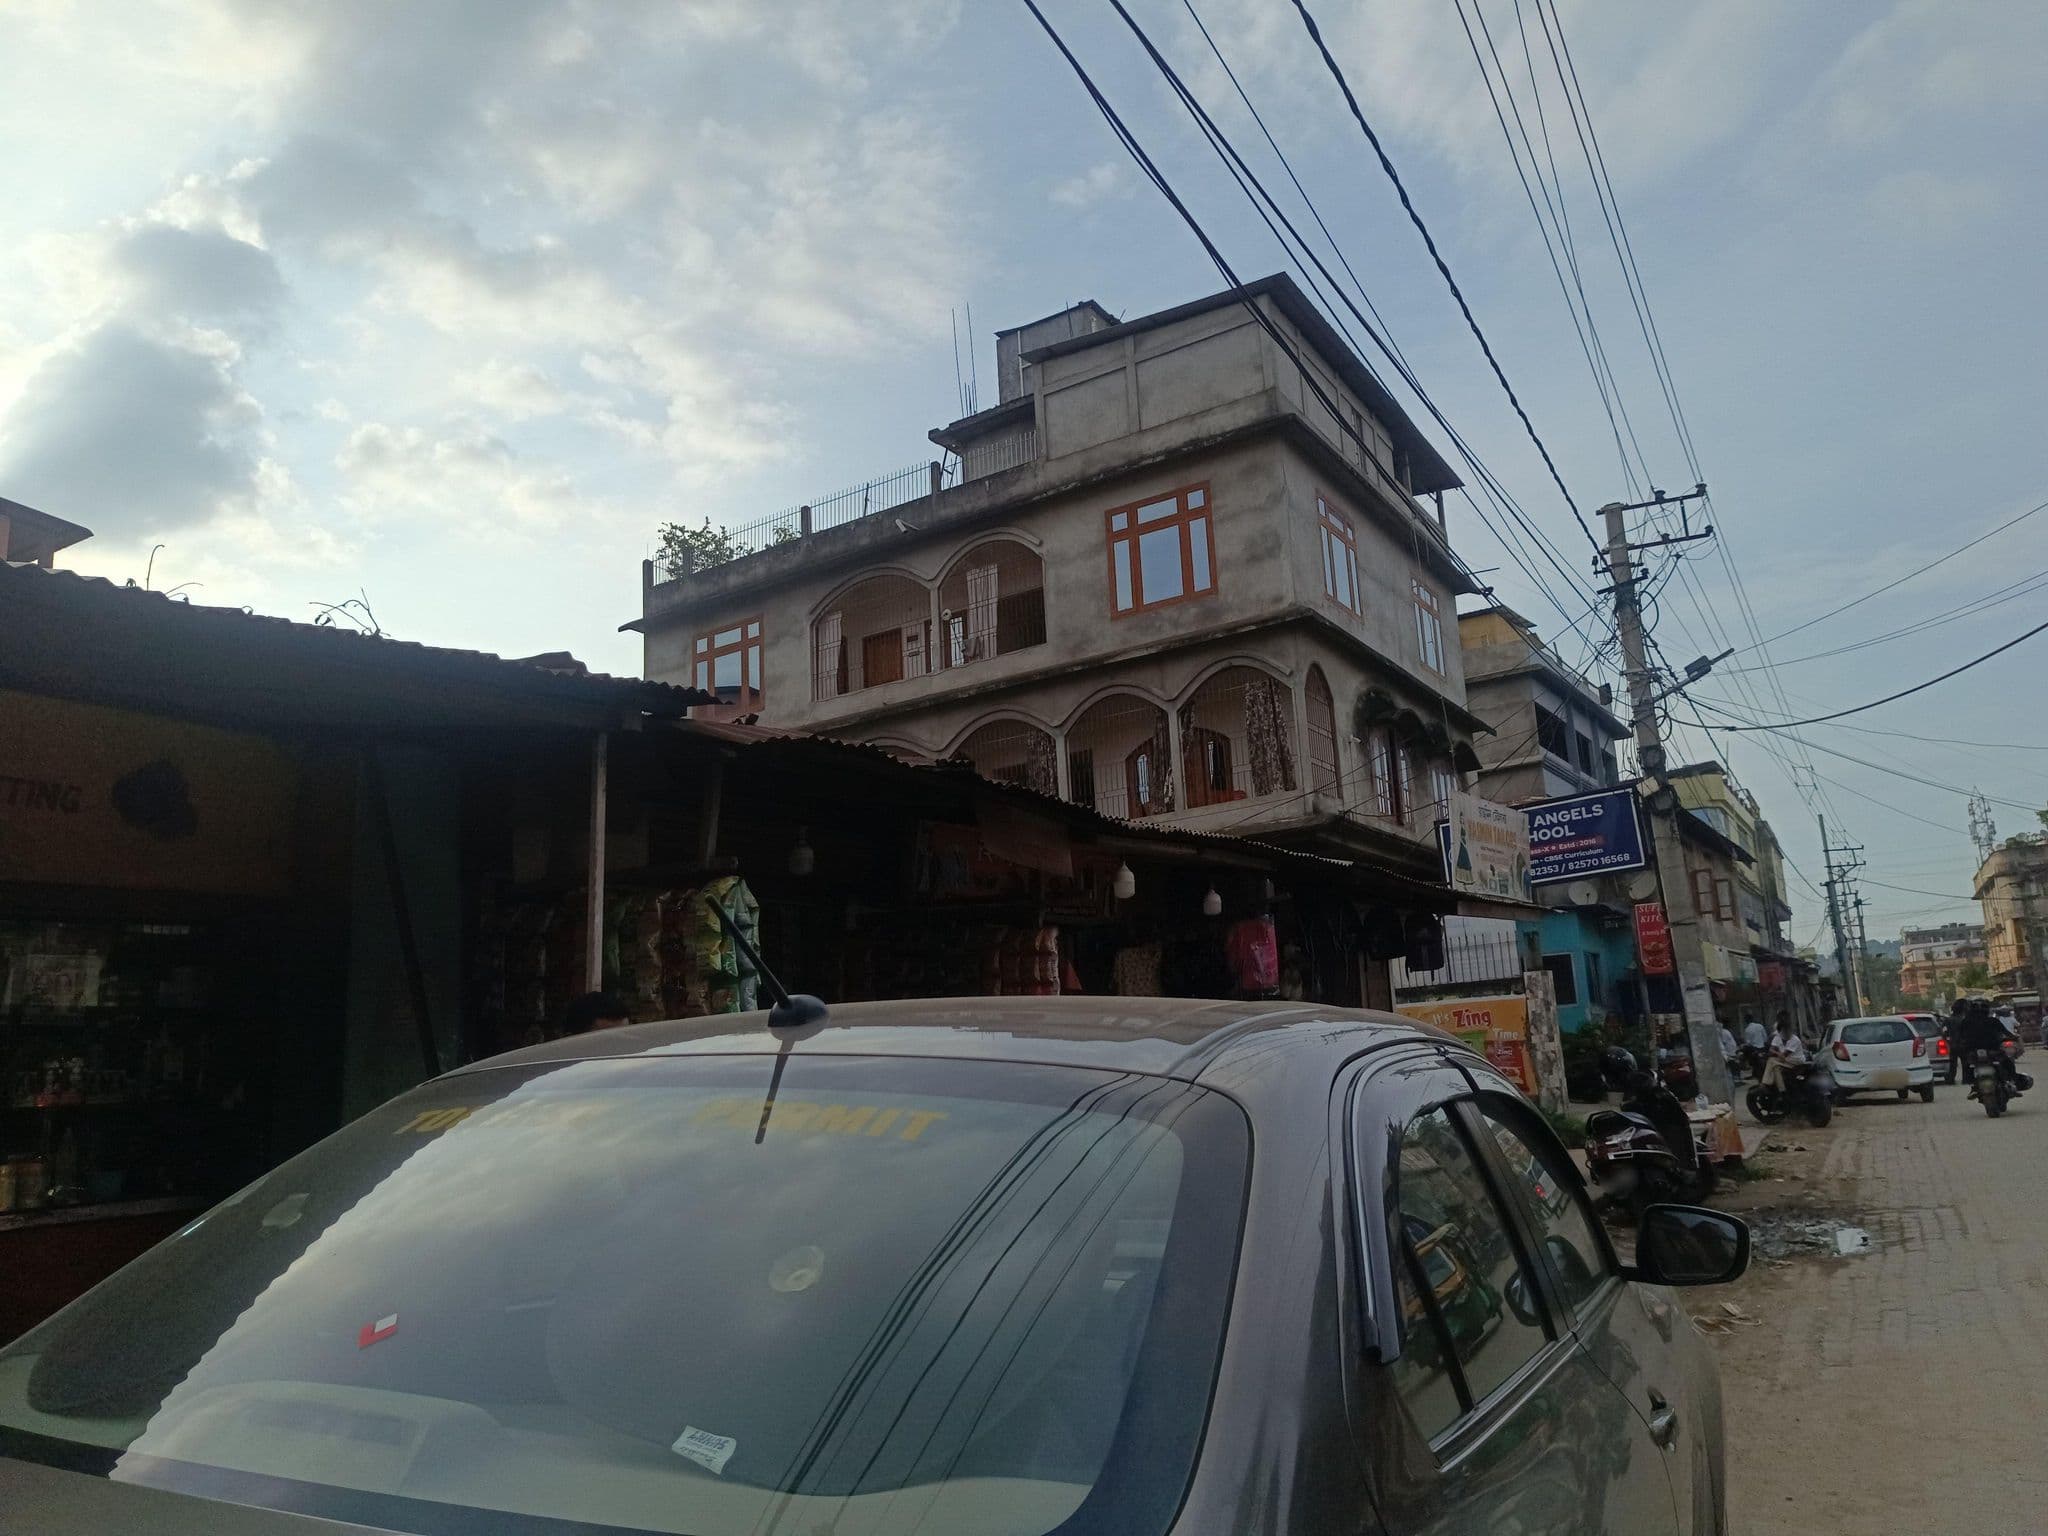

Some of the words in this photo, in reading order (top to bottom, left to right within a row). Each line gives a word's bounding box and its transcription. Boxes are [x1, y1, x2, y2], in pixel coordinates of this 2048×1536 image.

[1534, 804, 1604, 828] ANGELS
[1528, 825, 1576, 842] HOOL
[1544, 853, 1564, 863] CBSE
[1564, 847, 1604, 860] Curriculum
[1568, 858, 1599, 871] 82570
[1600, 853, 1630, 866] 16568
[1432, 1012, 1450, 1026] It's
[1452, 1008, 1492, 1028] Zing
[1492, 1027, 1519, 1040] Time
